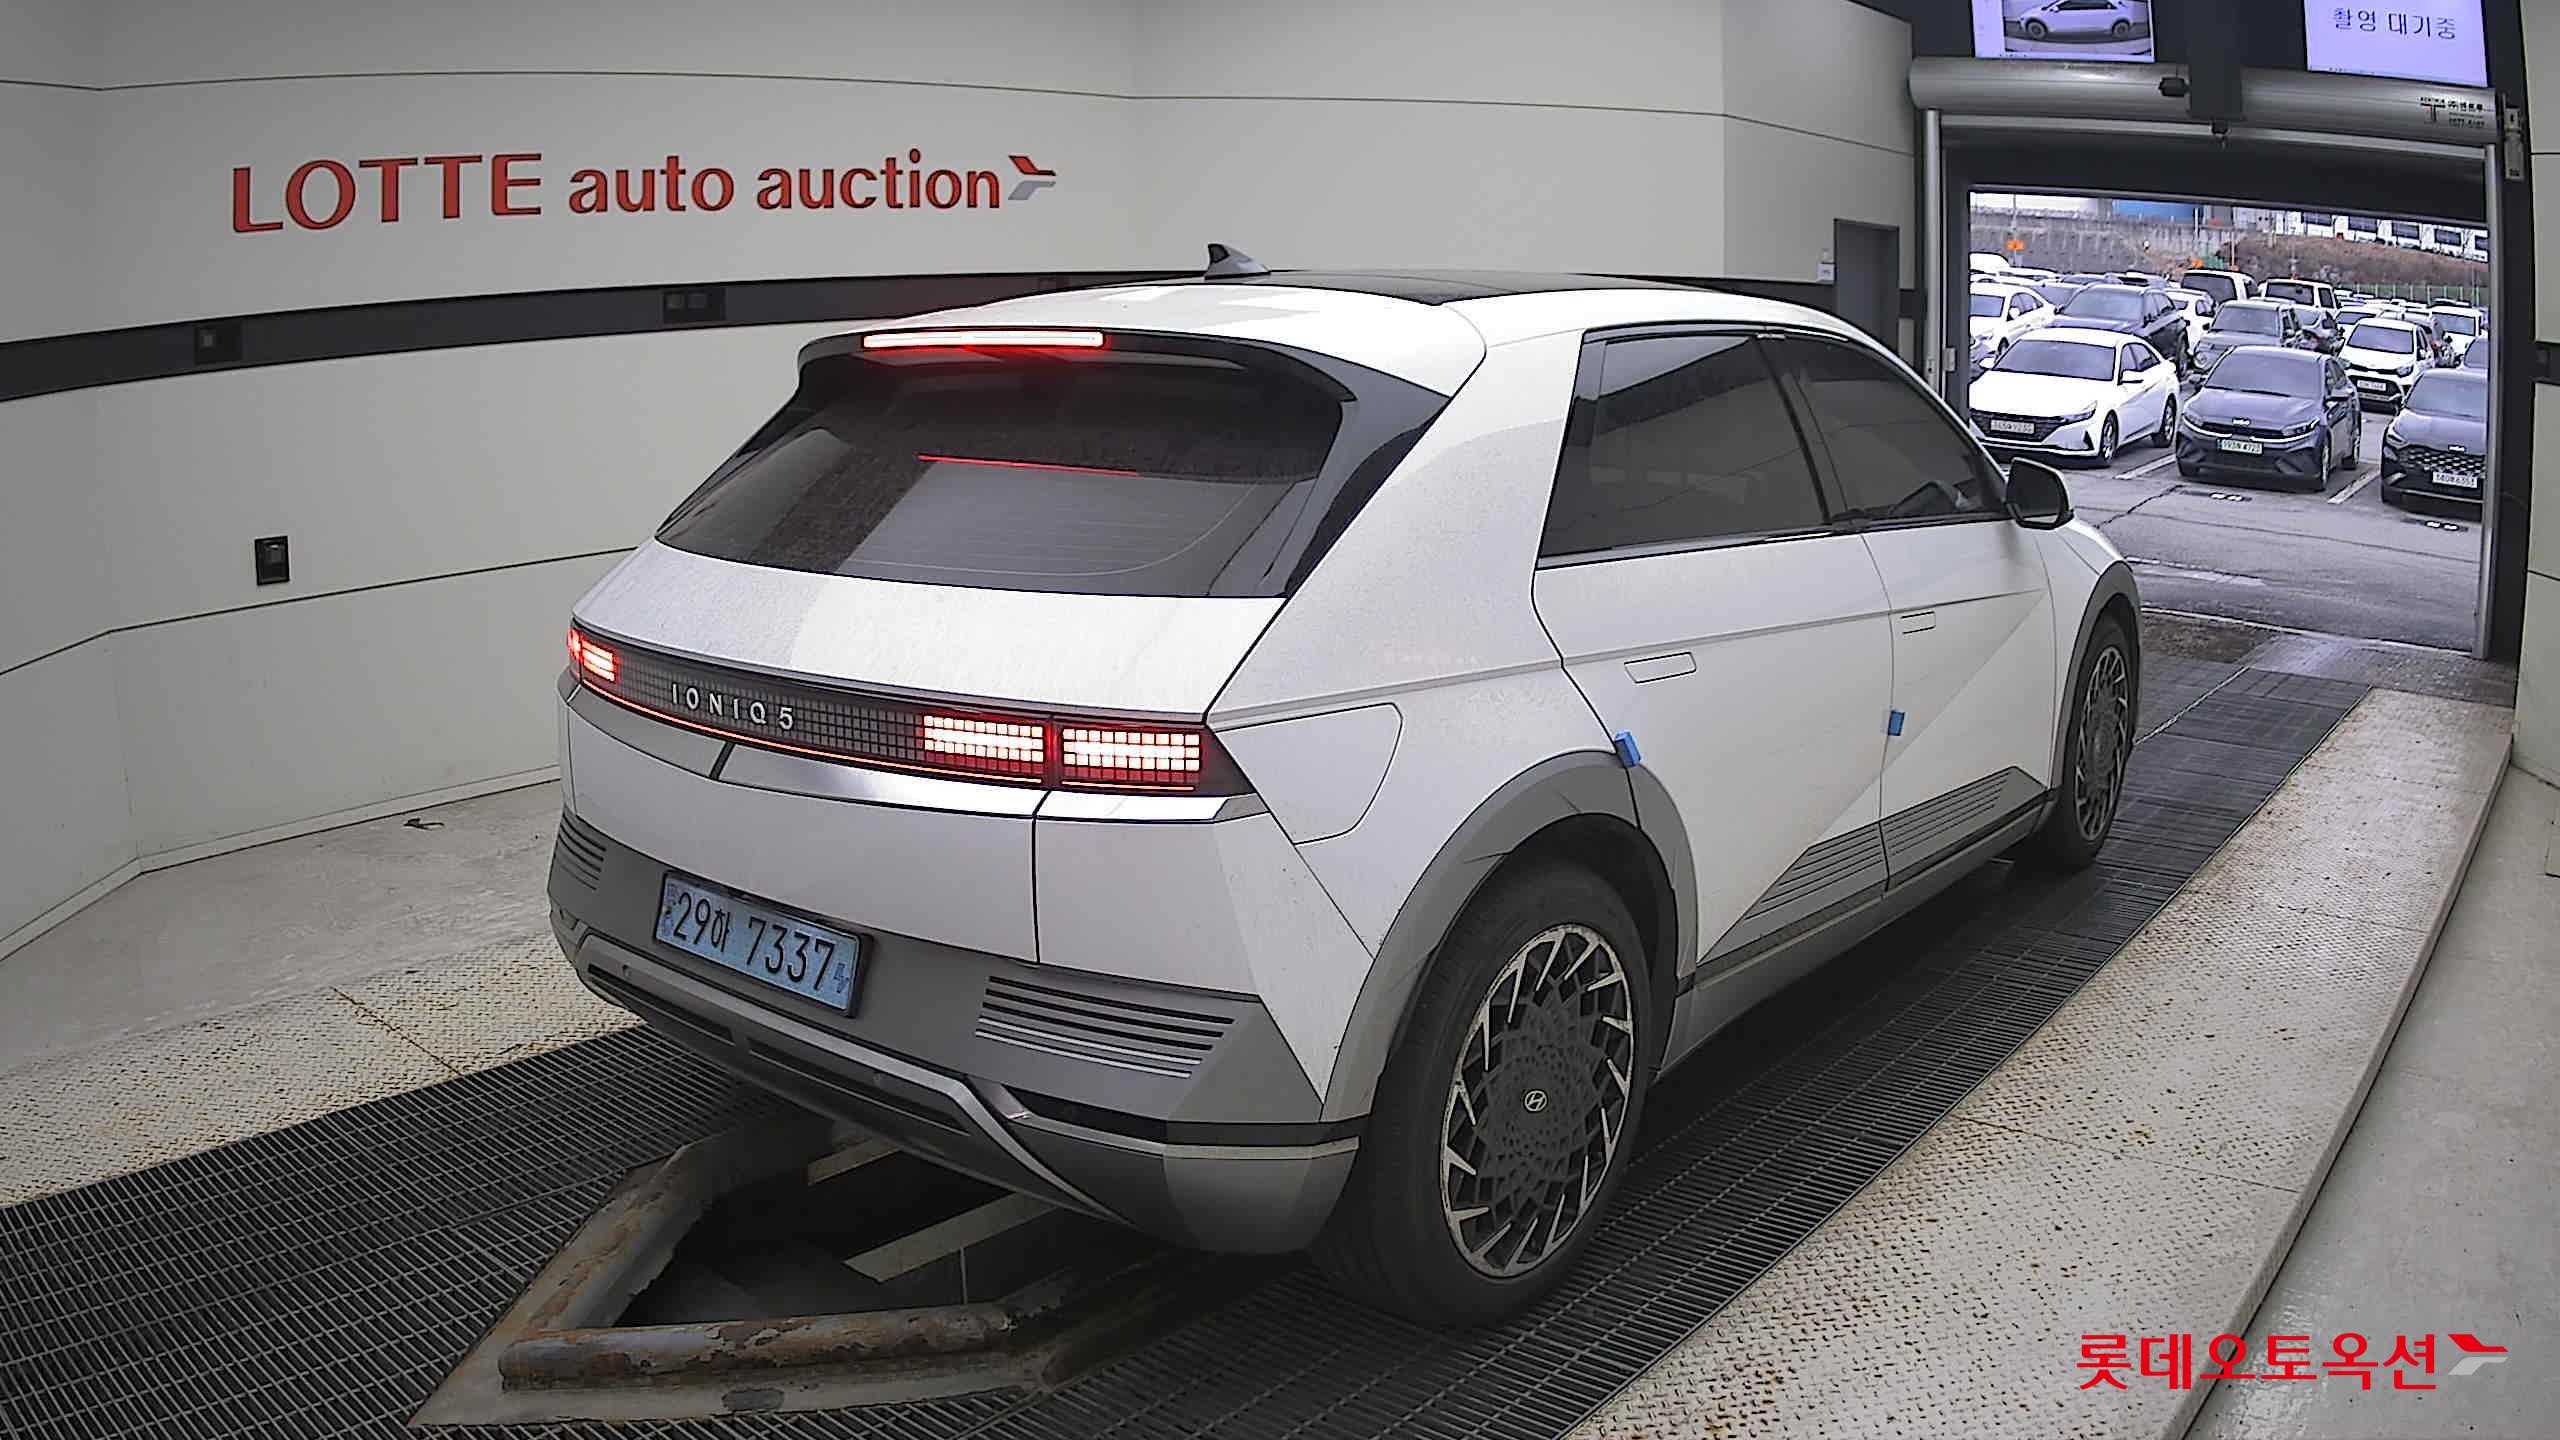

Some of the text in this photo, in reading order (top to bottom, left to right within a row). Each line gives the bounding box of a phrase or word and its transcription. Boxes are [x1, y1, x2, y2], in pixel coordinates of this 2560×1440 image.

[2387, 13, 2456, 40] 대기중
[233, 148, 1001, 233] LOTTE auto auction
[672, 683, 794, 730] IONIQ 5
[673, 892, 731, 952] 29하
[747, 916, 836, 990] 7337
